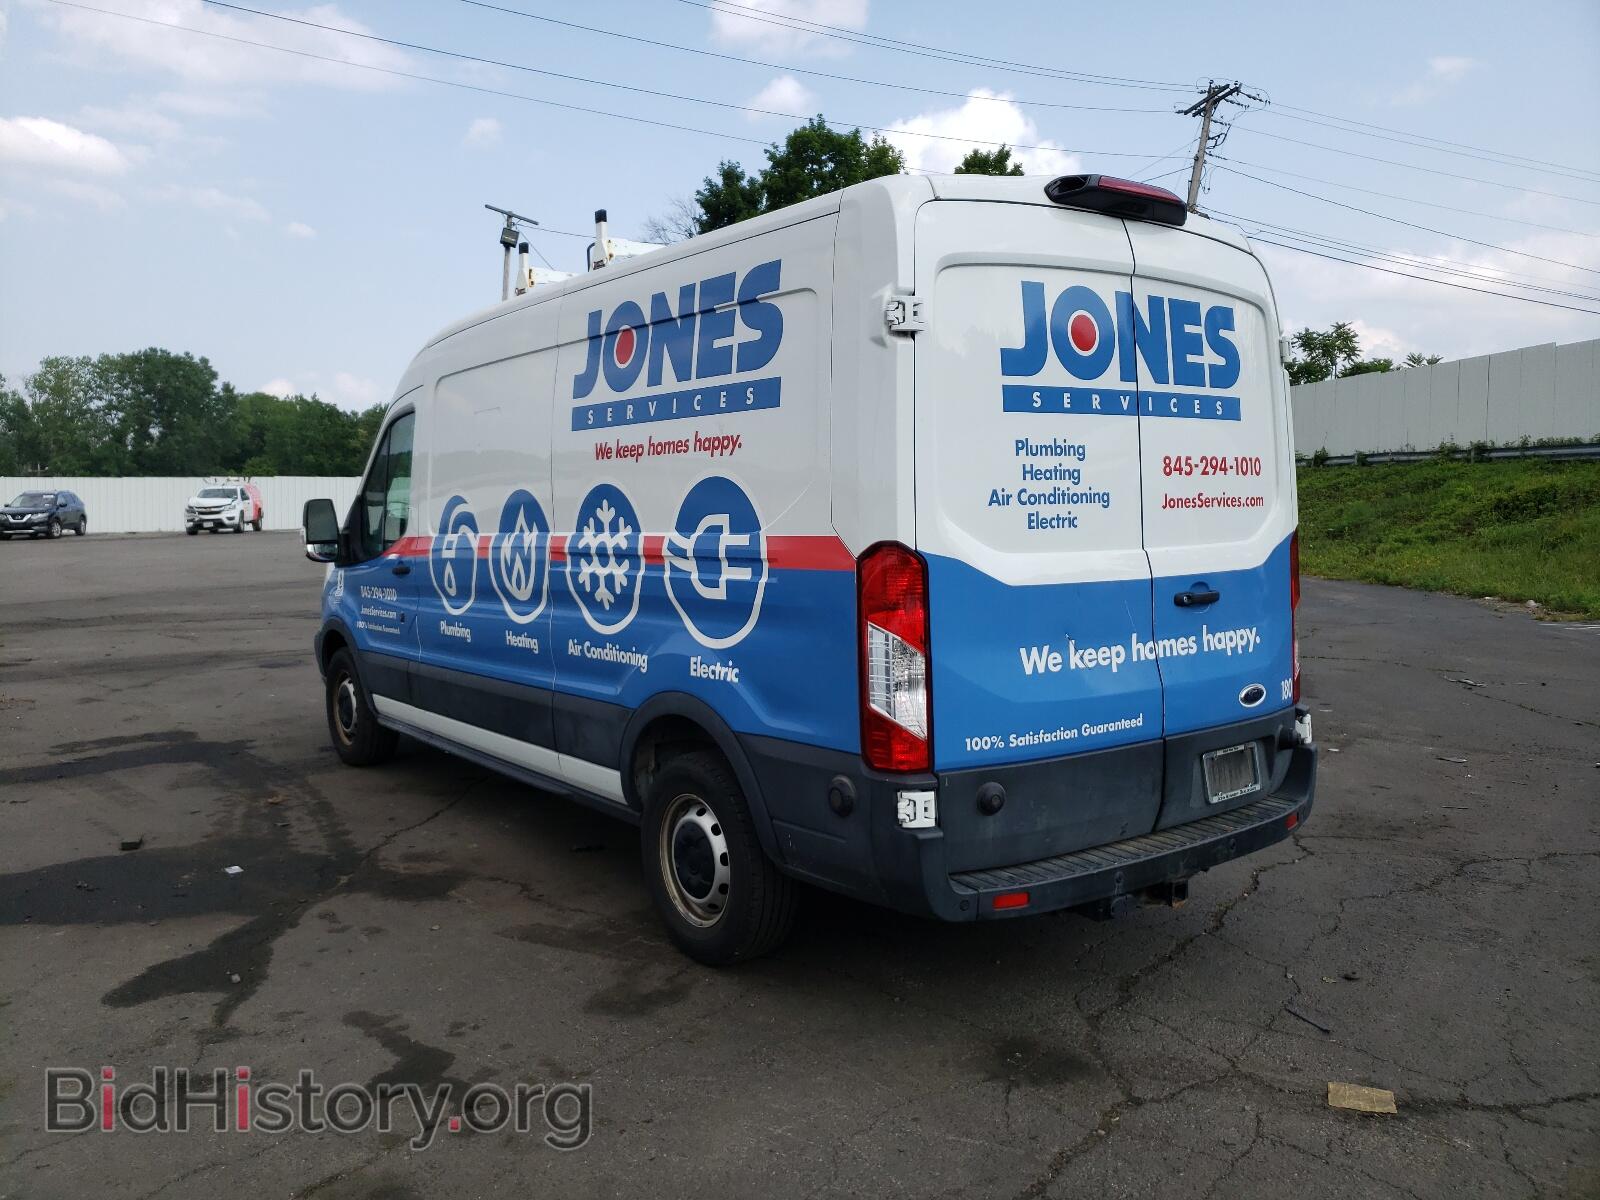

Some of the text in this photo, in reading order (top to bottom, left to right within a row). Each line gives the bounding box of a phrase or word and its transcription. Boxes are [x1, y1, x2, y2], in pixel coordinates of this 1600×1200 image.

[573, 259, 783, 399] JONES
[1000, 280, 1241, 389] JONES
[587, 387, 754, 424] SERVICES
[1032, 392, 1223, 415] SERVICES
[595, 431, 742, 463] We keep homes happy.
[1015, 438, 1086, 461] Plumbing
[1022, 461, 1081, 485] Heating
[1162, 455, 1262, 477] 845-294-1010
[988, 487, 1110, 509] Air Conditioning
[1162, 492, 1264, 510] JonesServices.com
[1027, 511, 1078, 530] Electric
[440, 620, 471, 643] Plumbing
[505, 630, 538, 654] Heating
[568, 639, 648, 673] Air Conditioning
[1020, 625, 1260, 675] We keep homes happy.
[690, 655, 739, 683] Electric
[1281, 678, 1293, 700] 180
[965, 713, 1143, 751] 100% Satisfaction Guaranteed
